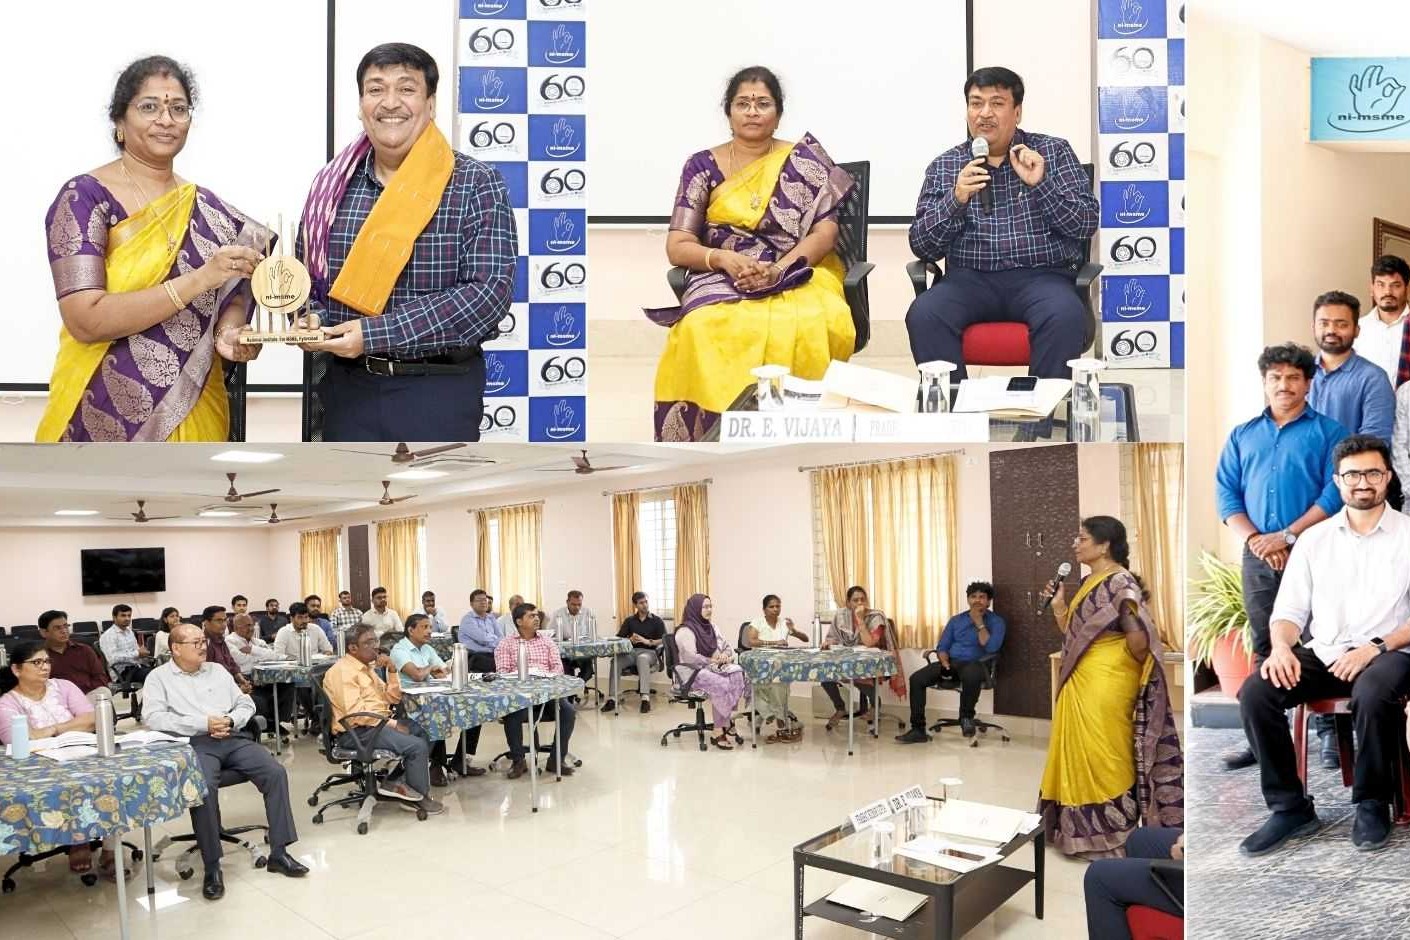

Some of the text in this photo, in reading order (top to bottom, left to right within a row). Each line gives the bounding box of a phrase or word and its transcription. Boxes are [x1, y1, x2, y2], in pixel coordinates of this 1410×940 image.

[469, 27, 515, 53] 60
[540, 74, 585, 100] 60
[1338, 112, 1405, 121] ni-msme
[469, 121, 515, 148] 60
[1109, 141, 1155, 168] 60
[541, 168, 586, 194] 60
[1110, 235, 1156, 262] 60
[541, 262, 586, 288] 60
[1111, 329, 1157, 356] 60
[541, 356, 586, 382] 60
[728, 416, 843, 438] DR. E. VIJAYA
